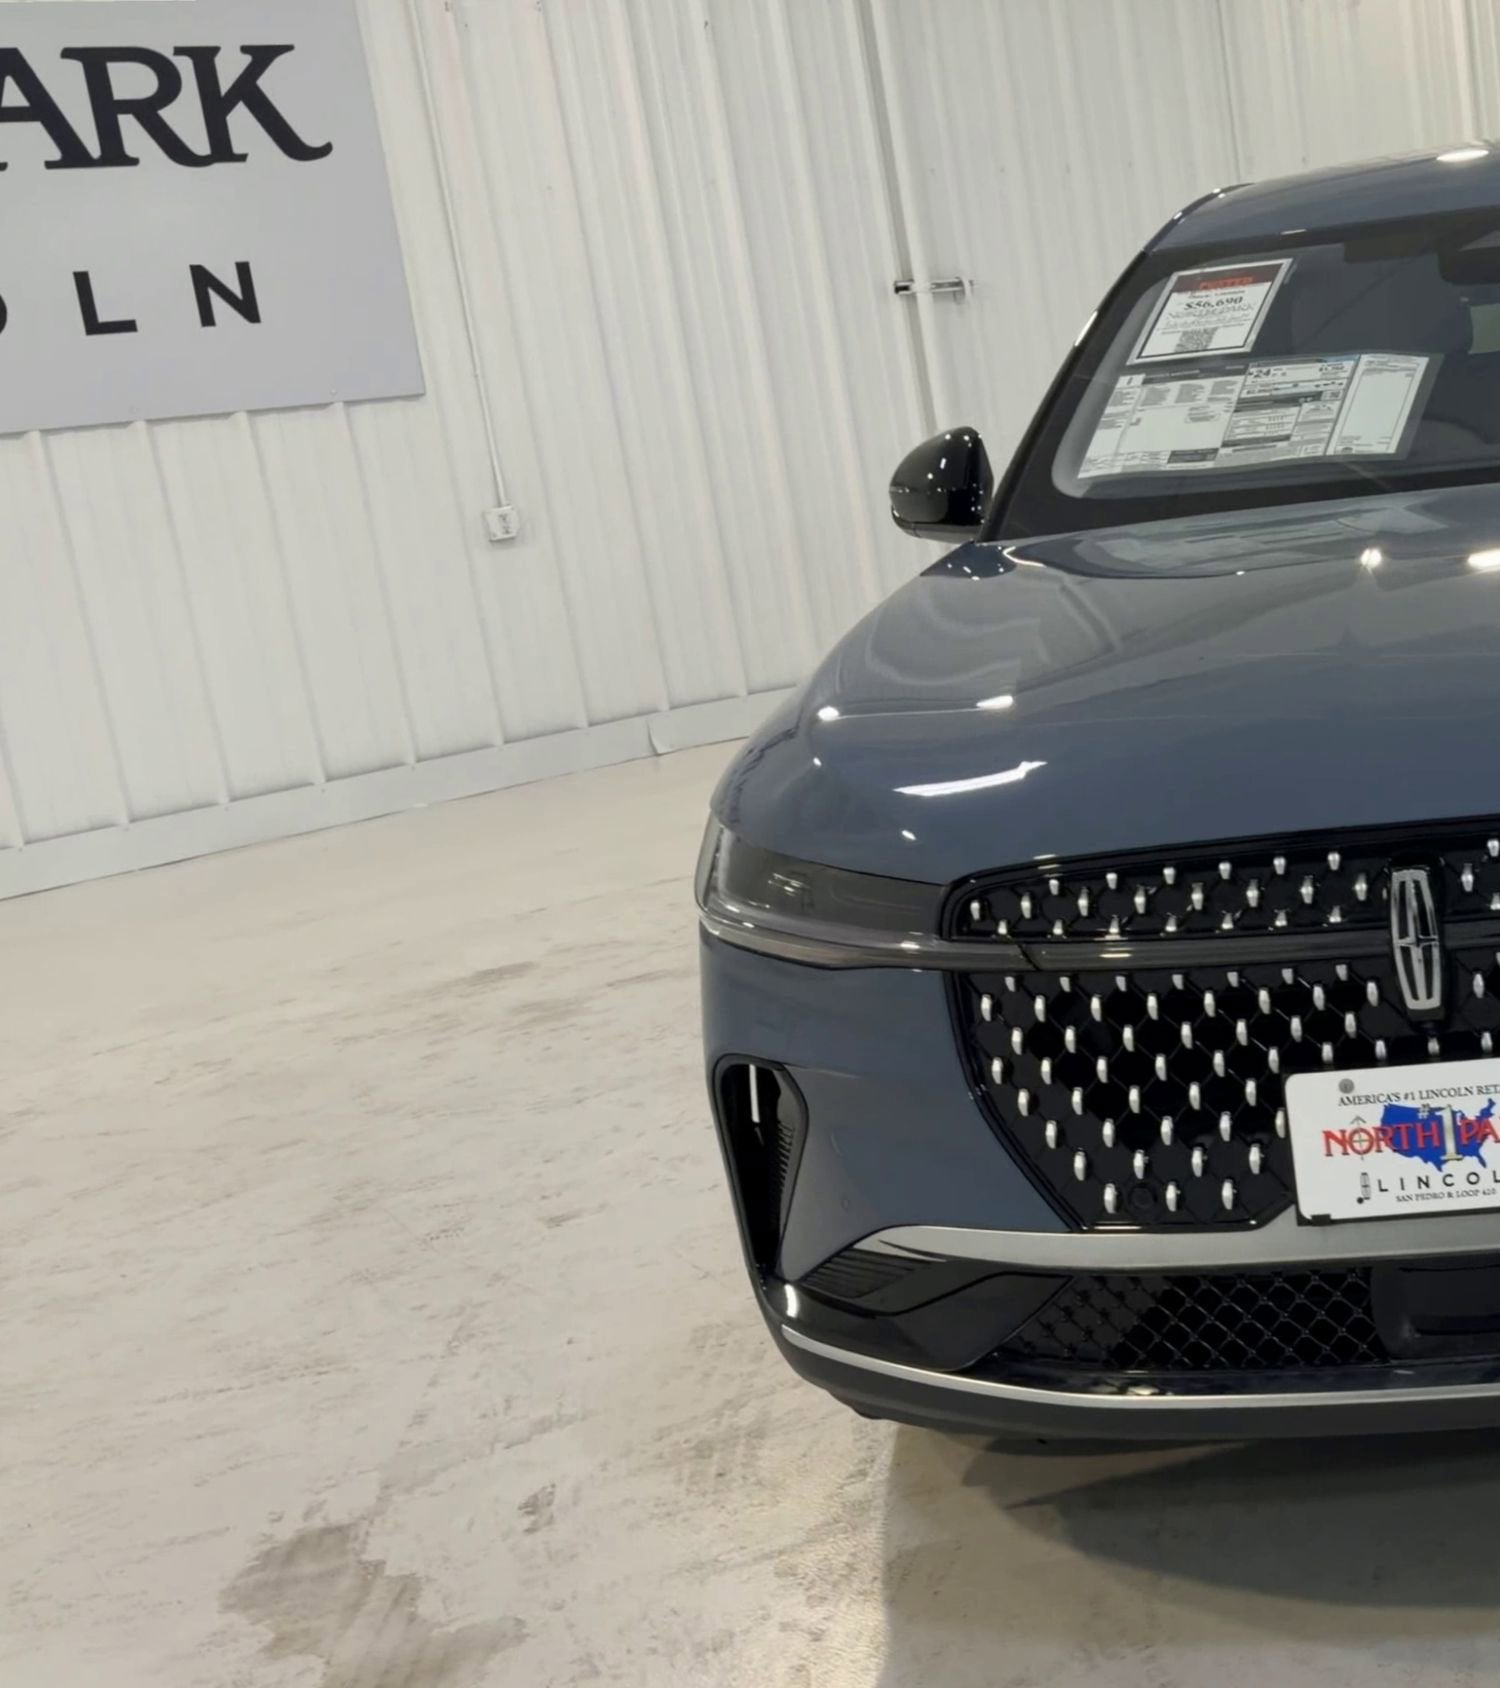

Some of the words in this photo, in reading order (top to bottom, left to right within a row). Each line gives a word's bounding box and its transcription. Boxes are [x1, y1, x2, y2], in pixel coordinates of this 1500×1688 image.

[0, 261, 261, 336] LN
[1338, 1092, 1401, 1107] AMERICA'S
[1404, 1090, 1415, 1101] #1
[1418, 1085, 1474, 1100] LINCOLN
[1322, 1120, 1441, 1157] NORTH
[1395, 1193, 1413, 1202] SAN
[1414, 1191, 1445, 1201] PEDRO
[1456, 1189, 1479, 1198] LOOP
